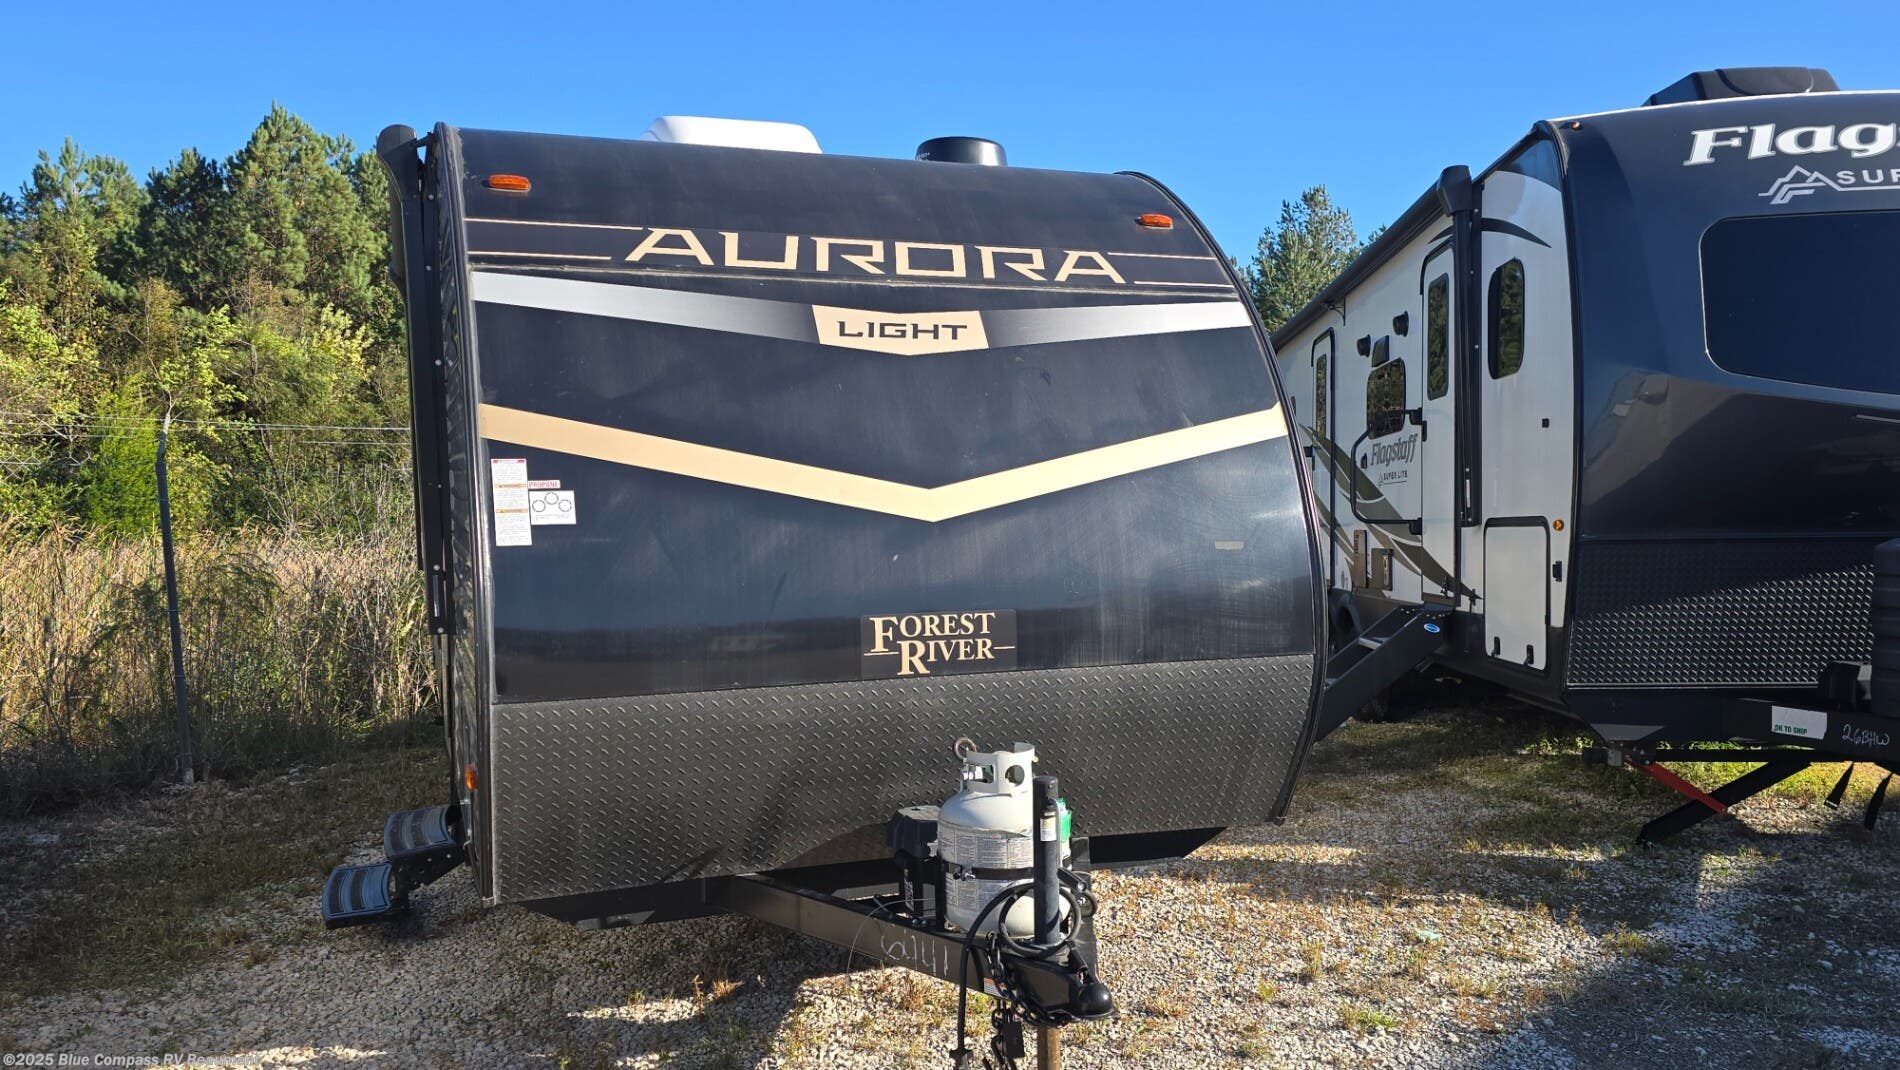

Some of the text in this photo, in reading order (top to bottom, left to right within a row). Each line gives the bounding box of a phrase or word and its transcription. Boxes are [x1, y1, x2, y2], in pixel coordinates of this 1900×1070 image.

[1683, 122, 1900, 166] Flag
[624, 227, 1126, 284] AURORA
[836, 320, 968, 341] LIGHT
[1370, 433, 1418, 467] Flagstaff
[869, 612, 996, 653] FOREST
[896, 638, 996, 676] RIVER
[1784, 725, 1792, 733] TO
[1842, 723, 1890, 746] 26BHW
